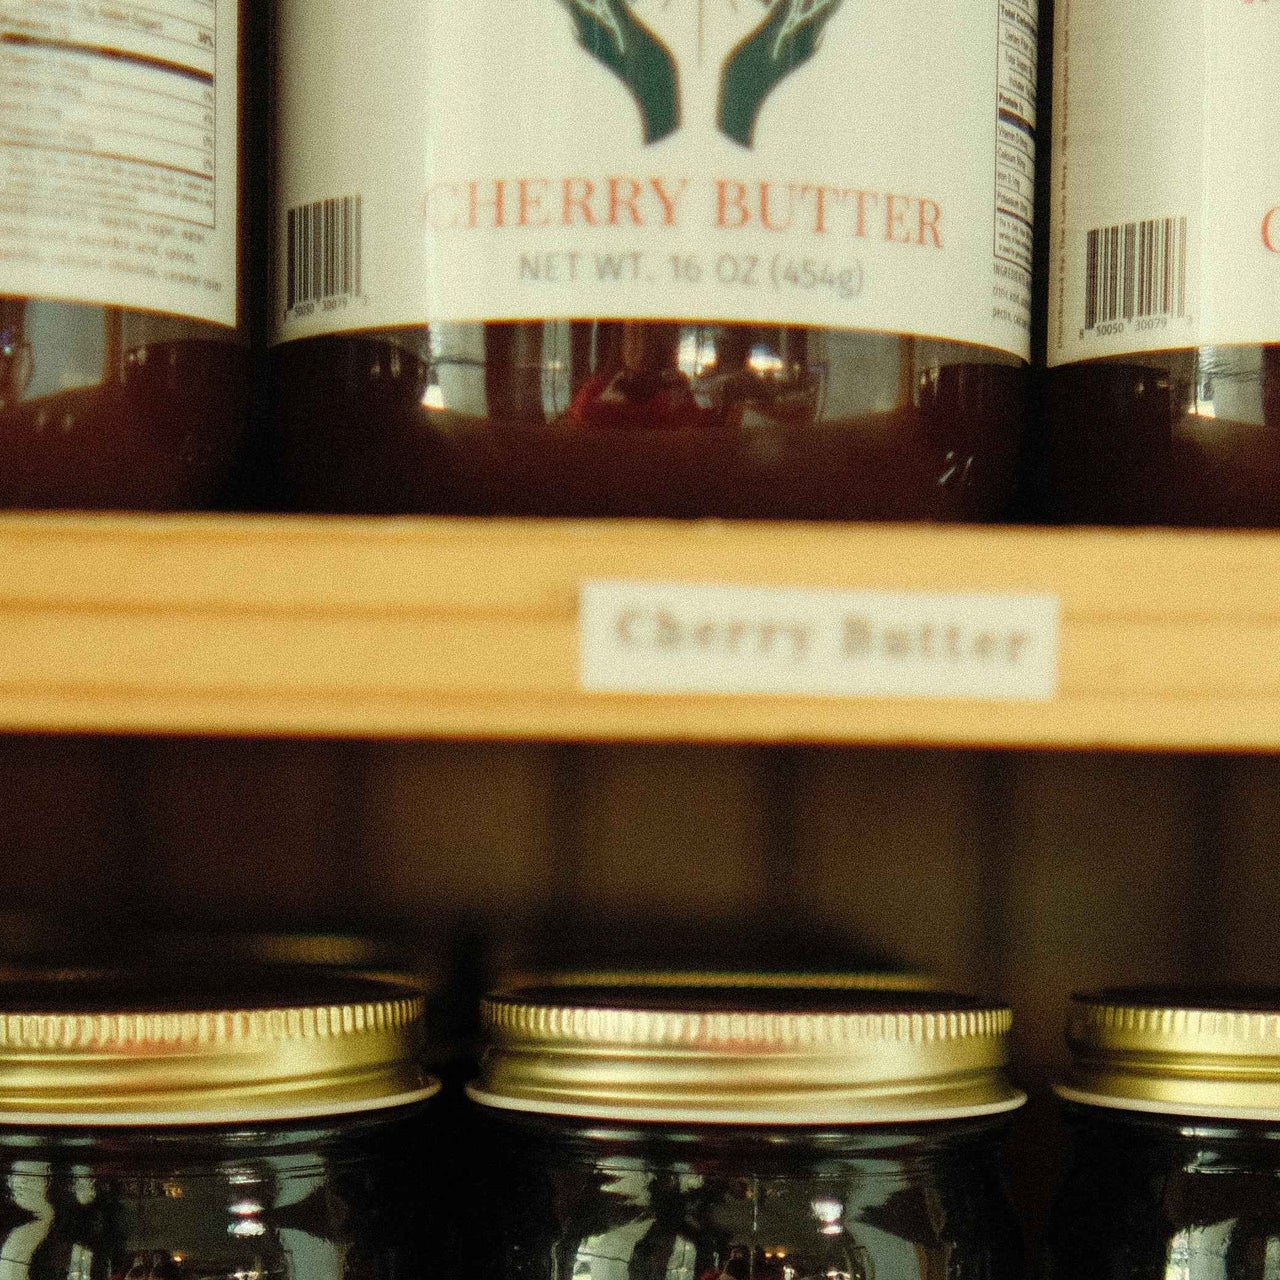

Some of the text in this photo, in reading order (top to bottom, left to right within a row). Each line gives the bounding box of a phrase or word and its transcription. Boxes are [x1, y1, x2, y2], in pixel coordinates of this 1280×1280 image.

[422, 174, 944, 248] CHERRY BUTTER
[518, 250, 865, 299] NET WT. 16 OZ (454g)
[614, 607, 1029, 665] Cherry Butter
